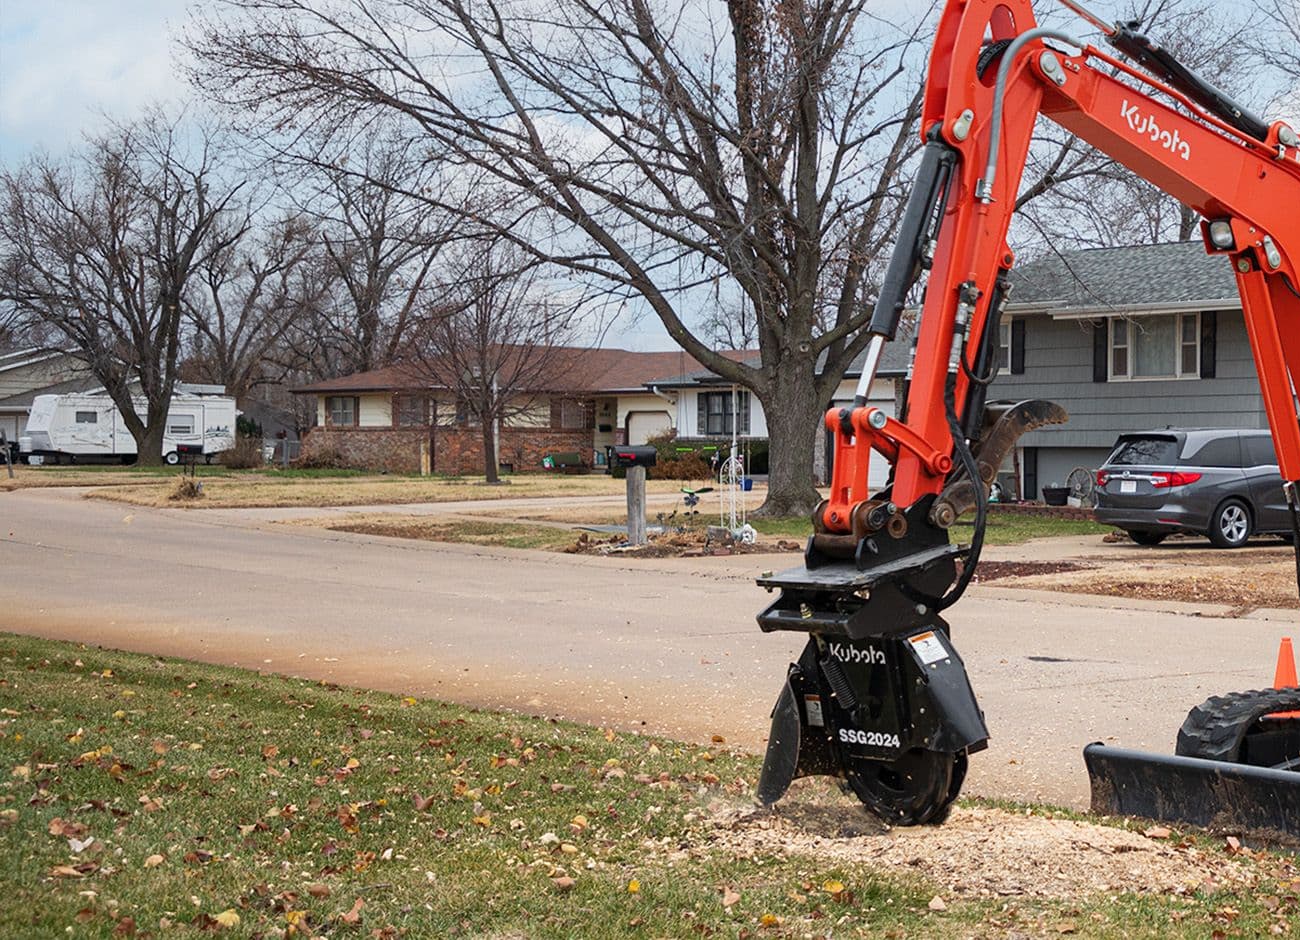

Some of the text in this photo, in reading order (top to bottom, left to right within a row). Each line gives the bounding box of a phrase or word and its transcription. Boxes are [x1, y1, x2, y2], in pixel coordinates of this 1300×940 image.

[1121, 99, 1191, 160] Kubota
[829, 643, 886, 664] Kubota
[839, 728, 901, 748] SSG2024
